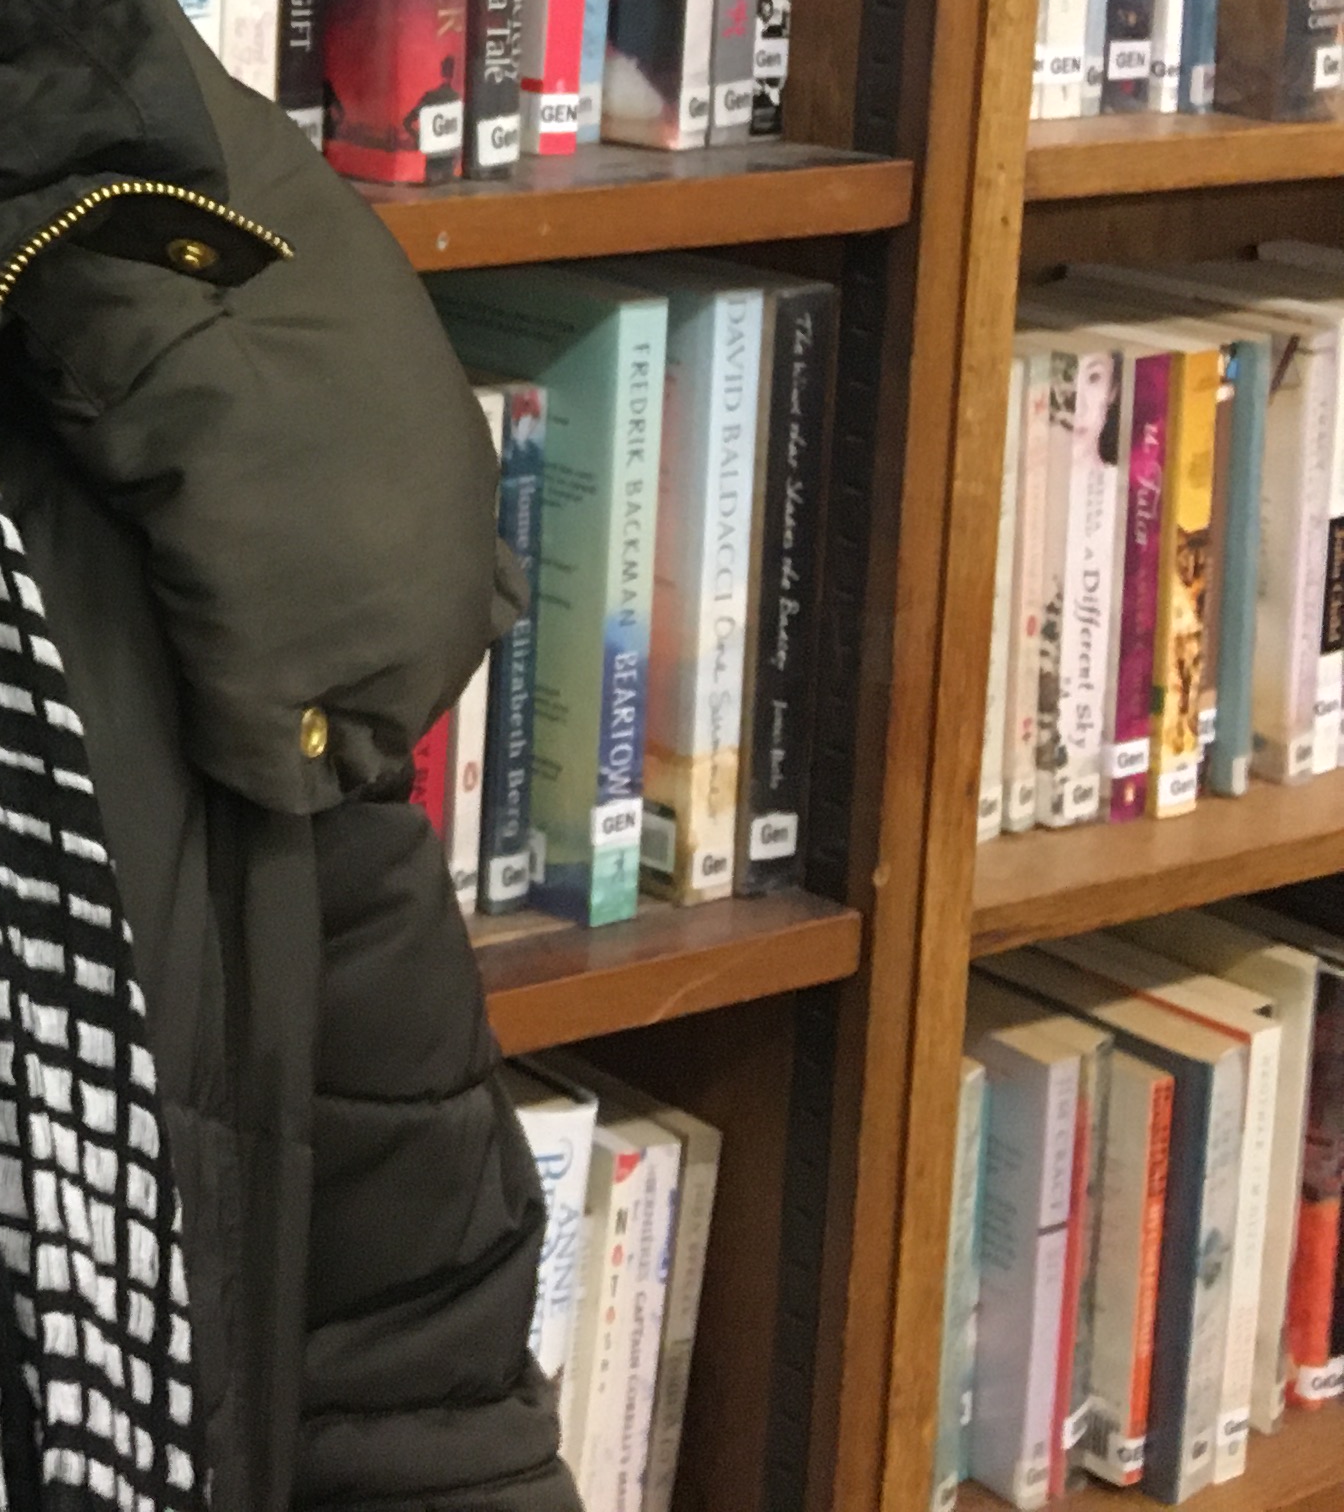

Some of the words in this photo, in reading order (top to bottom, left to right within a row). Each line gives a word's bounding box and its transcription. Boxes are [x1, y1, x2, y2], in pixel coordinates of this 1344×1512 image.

[482, 24, 511, 84] Tale
[756, 48, 782, 70] Gen
[1050, 55, 1082, 75] GEN
[1115, 51, 1146, 70] GEN
[540, 104, 579, 124] GEN
[723, 90, 751, 112] Gen
[431, 112, 459, 137] Gen
[722, 296, 748, 414] DAVID
[625, 343, 652, 467] FREDRIK
[515, 475, 537, 549] Home
[712, 424, 744, 602] BALDACCI
[616, 479, 644, 628] BACKMAN
[1073, 568, 1101, 693] Different
[507, 617, 534, 760] Elizabeth
[1068, 703, 1094, 750] Sky
[1116, 750, 1144, 770] Gen
[499, 766, 526, 839] Berg
[602, 816, 636, 834] GEN
[759, 824, 790, 845] Gen
[702, 854, 728, 878] Gen
